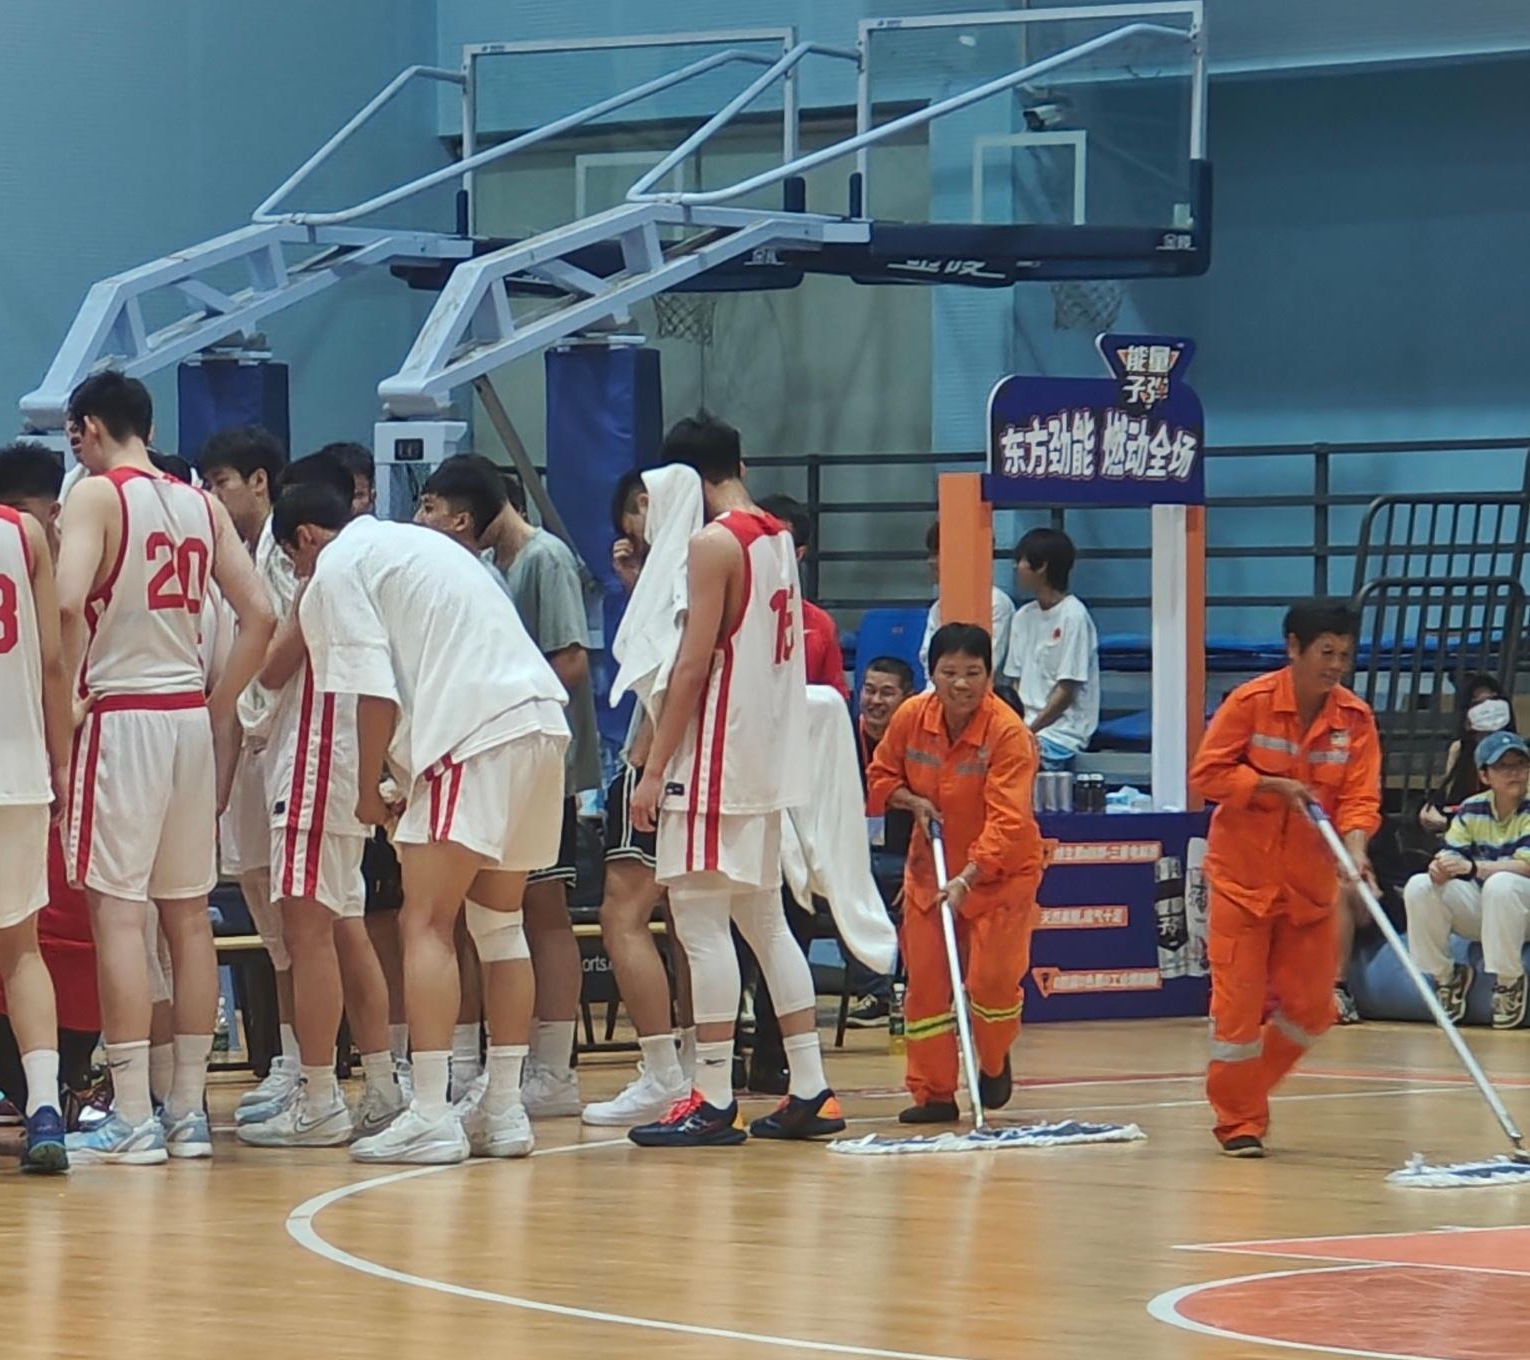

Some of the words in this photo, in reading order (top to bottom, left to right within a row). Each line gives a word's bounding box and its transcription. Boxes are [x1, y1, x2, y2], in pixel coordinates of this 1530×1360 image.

[1001, 410, 1095, 476] 东方劲能
[1100, 409, 1198, 478] 燃动全场
[146, 531, 210, 615] 20
